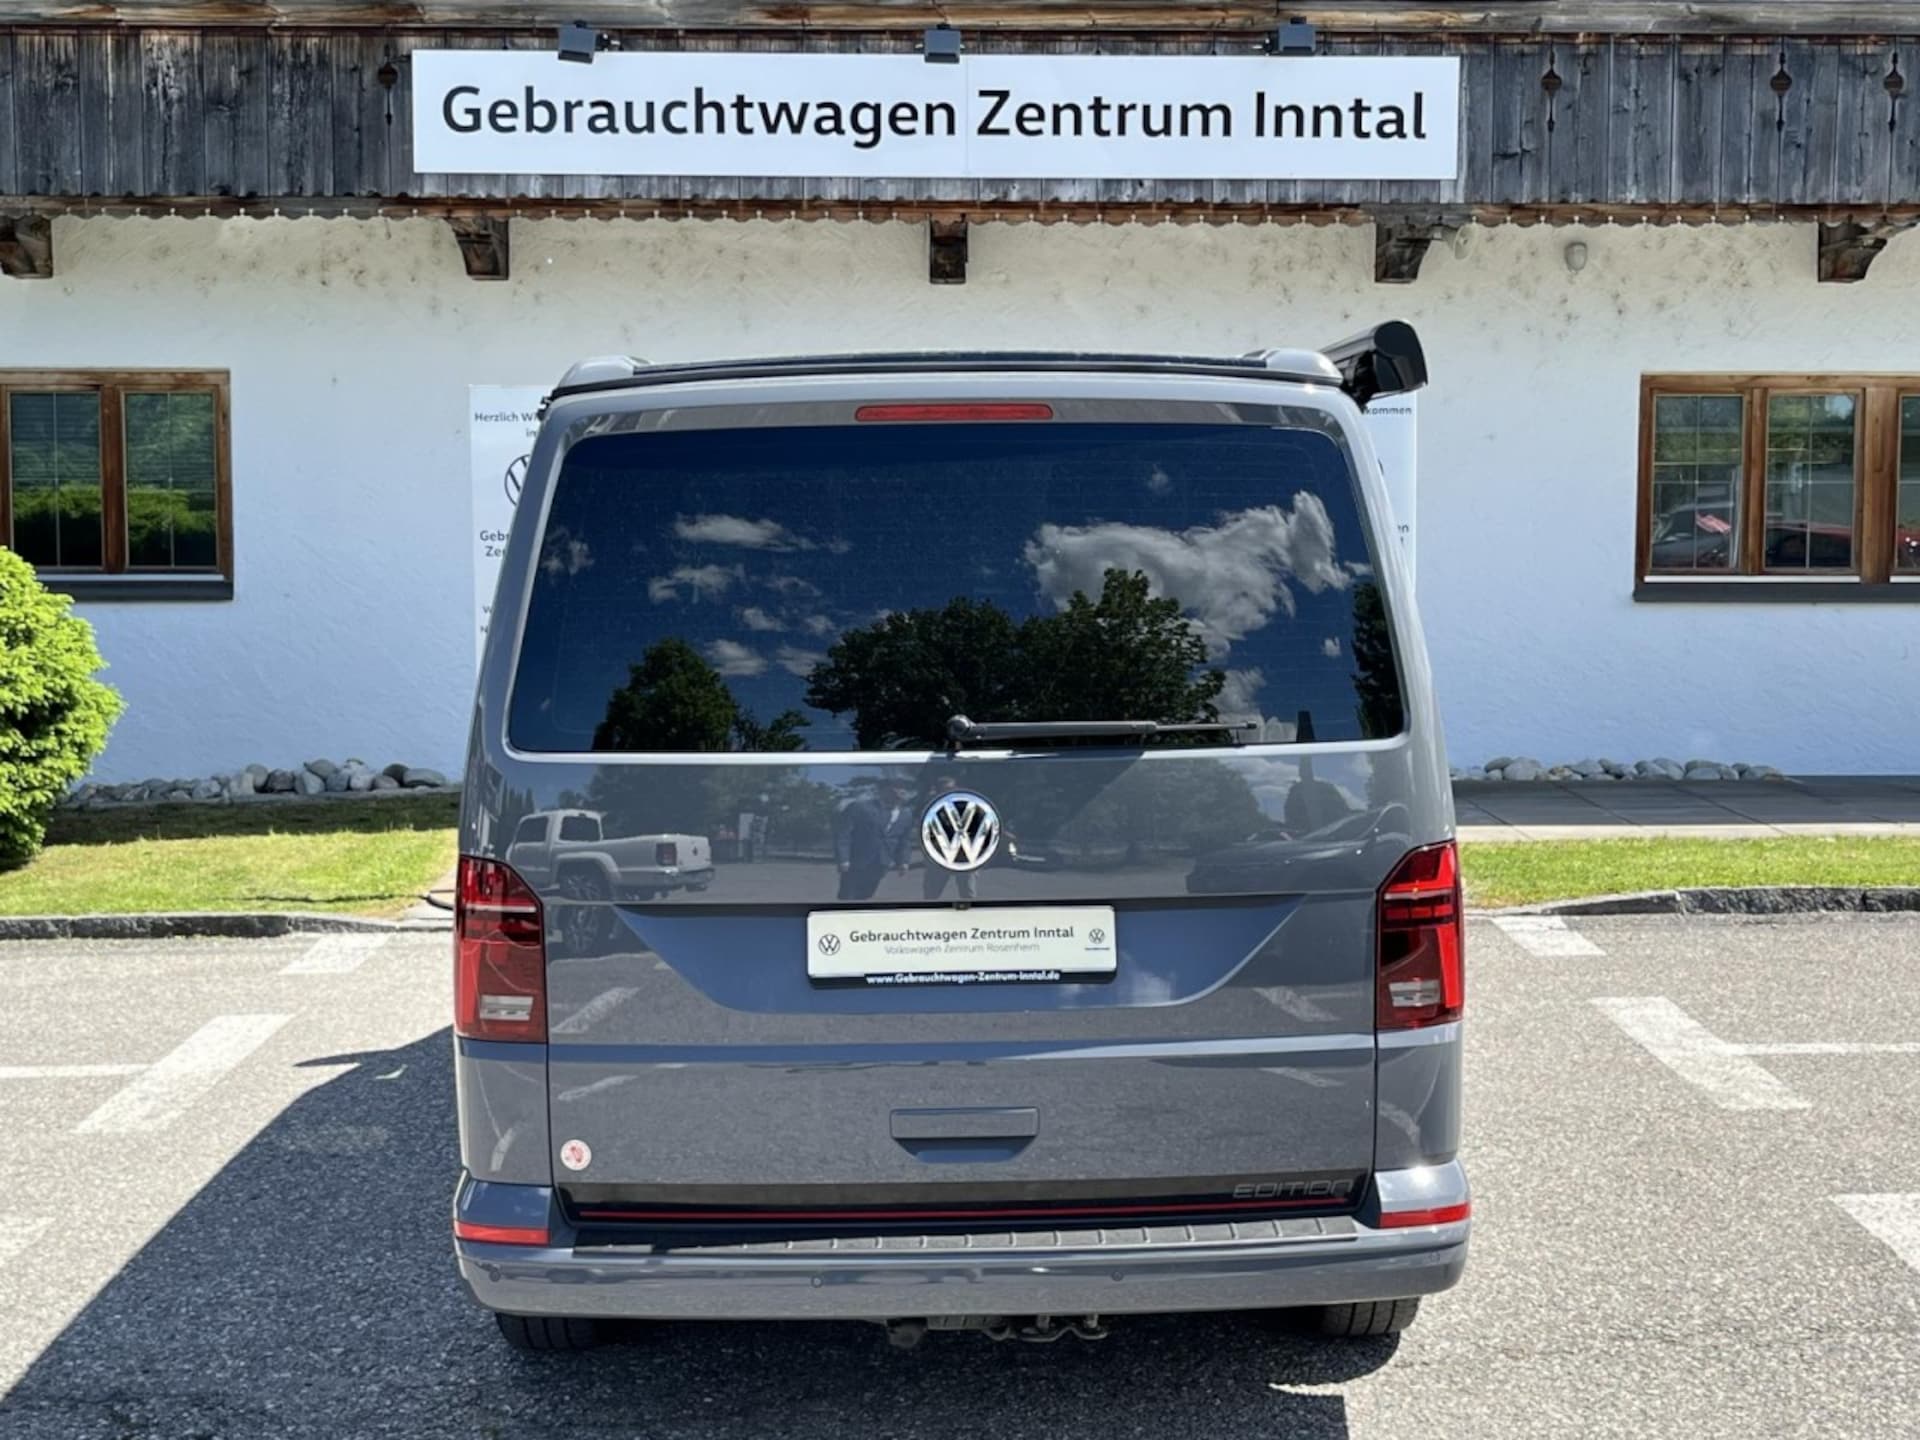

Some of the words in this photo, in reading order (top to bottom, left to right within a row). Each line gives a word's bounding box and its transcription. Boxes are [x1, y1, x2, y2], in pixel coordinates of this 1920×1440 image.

[442, 85, 956, 149] Gebrauchtwagen
[977, 89, 1232, 138] Zentrum
[1255, 91, 1427, 140] Inntal
[474, 411, 519, 422] Herzlich
[849, 928, 967, 944] Gebrauchtwagen
[971, 927, 1031, 941] Zentrum
[1033, 925, 1075, 940] Inntal
[884, 943, 942, 956] Volkswagen
[944, 942, 986, 954] Zentrum
[986, 940, 1040, 953] Rosenheim
[1232, 1178, 1354, 1199] EDITION
